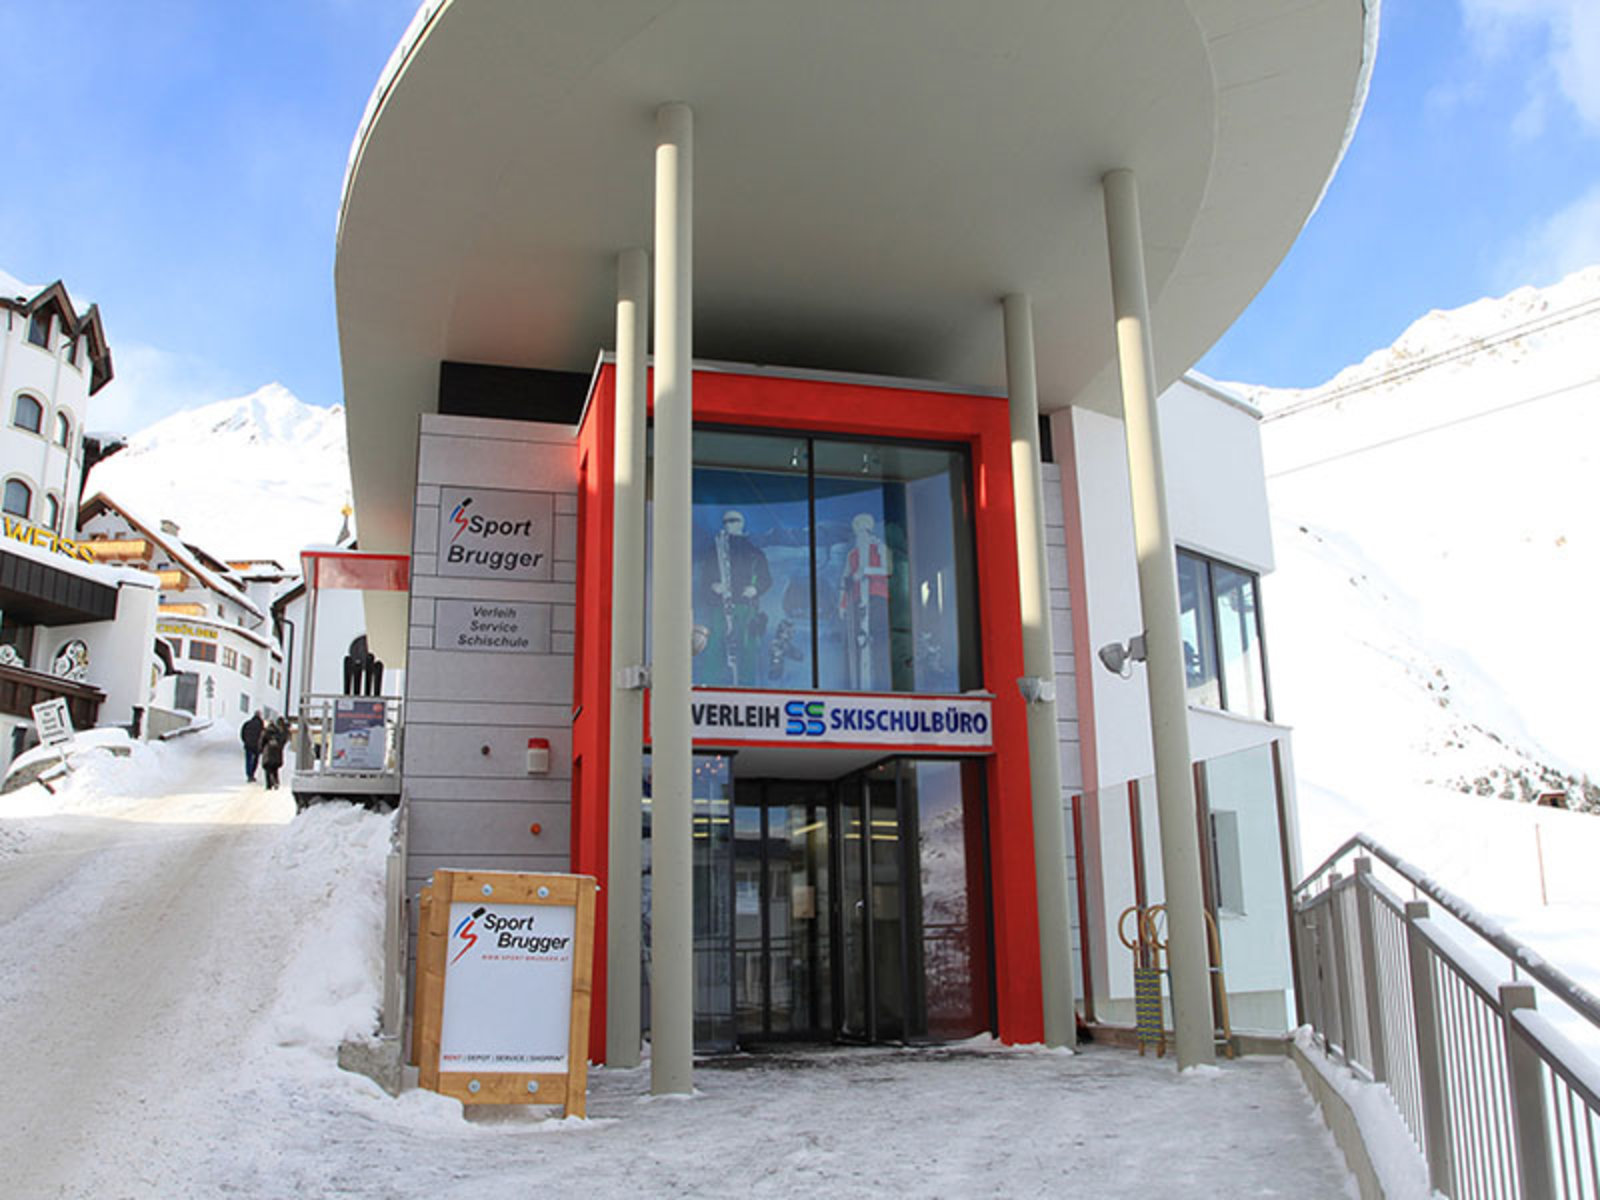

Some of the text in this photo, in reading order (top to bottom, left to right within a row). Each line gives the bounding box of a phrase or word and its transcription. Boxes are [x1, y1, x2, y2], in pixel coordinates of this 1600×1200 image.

[468, 515, 532, 538] Sport
[4, 516, 97, 564] WEISS
[447, 544, 544, 570] Brugger
[473, 606, 517, 618] Verleih
[470, 620, 518, 633] Service
[458, 634, 529, 648] Schischule
[691, 703, 780, 728] VERLEIH
[830, 706, 988, 734] SKISCHULBÜRO
[484, 913, 534, 933] Sport
[497, 932, 570, 953] Brugger
